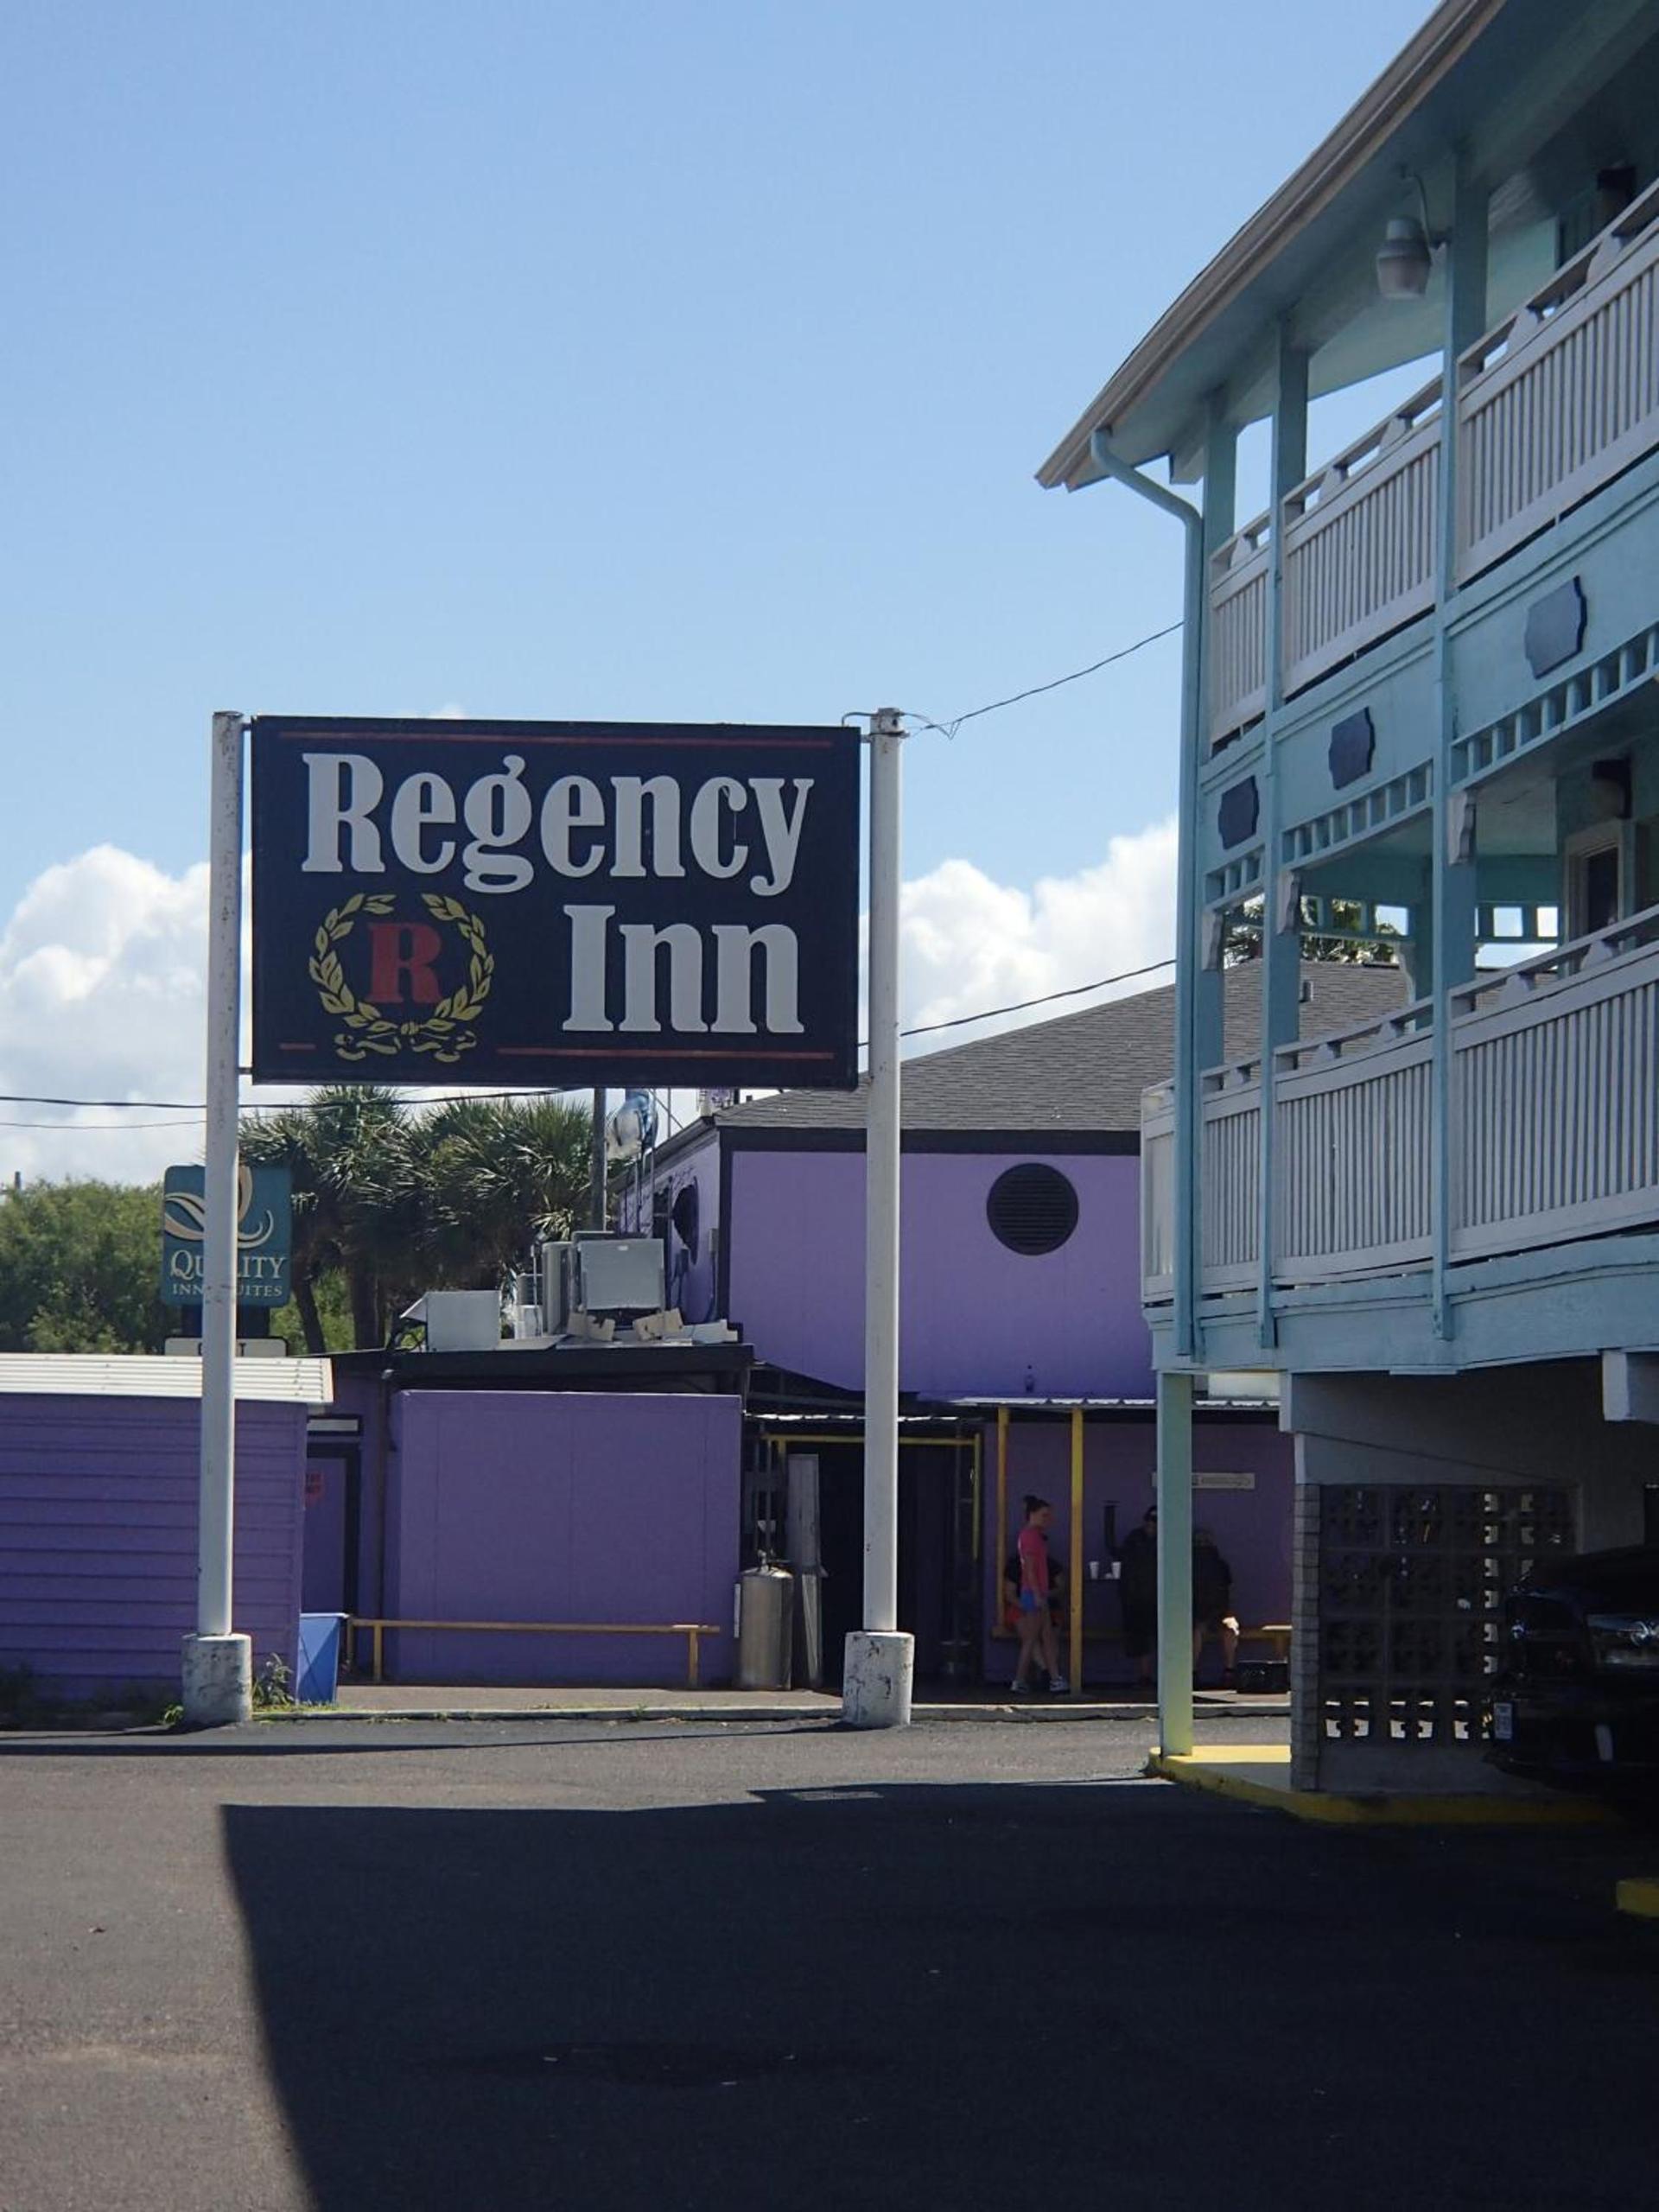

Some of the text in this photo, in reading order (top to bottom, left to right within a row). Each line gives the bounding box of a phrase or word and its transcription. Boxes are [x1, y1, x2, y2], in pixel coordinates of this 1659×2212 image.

[300, 753, 815, 896] Regency
[367, 921, 443, 1004] R
[562, 904, 805, 1034] Inn
[170, 1249, 286, 1281] QUITY
[237, 1285, 283, 1297] ITES
